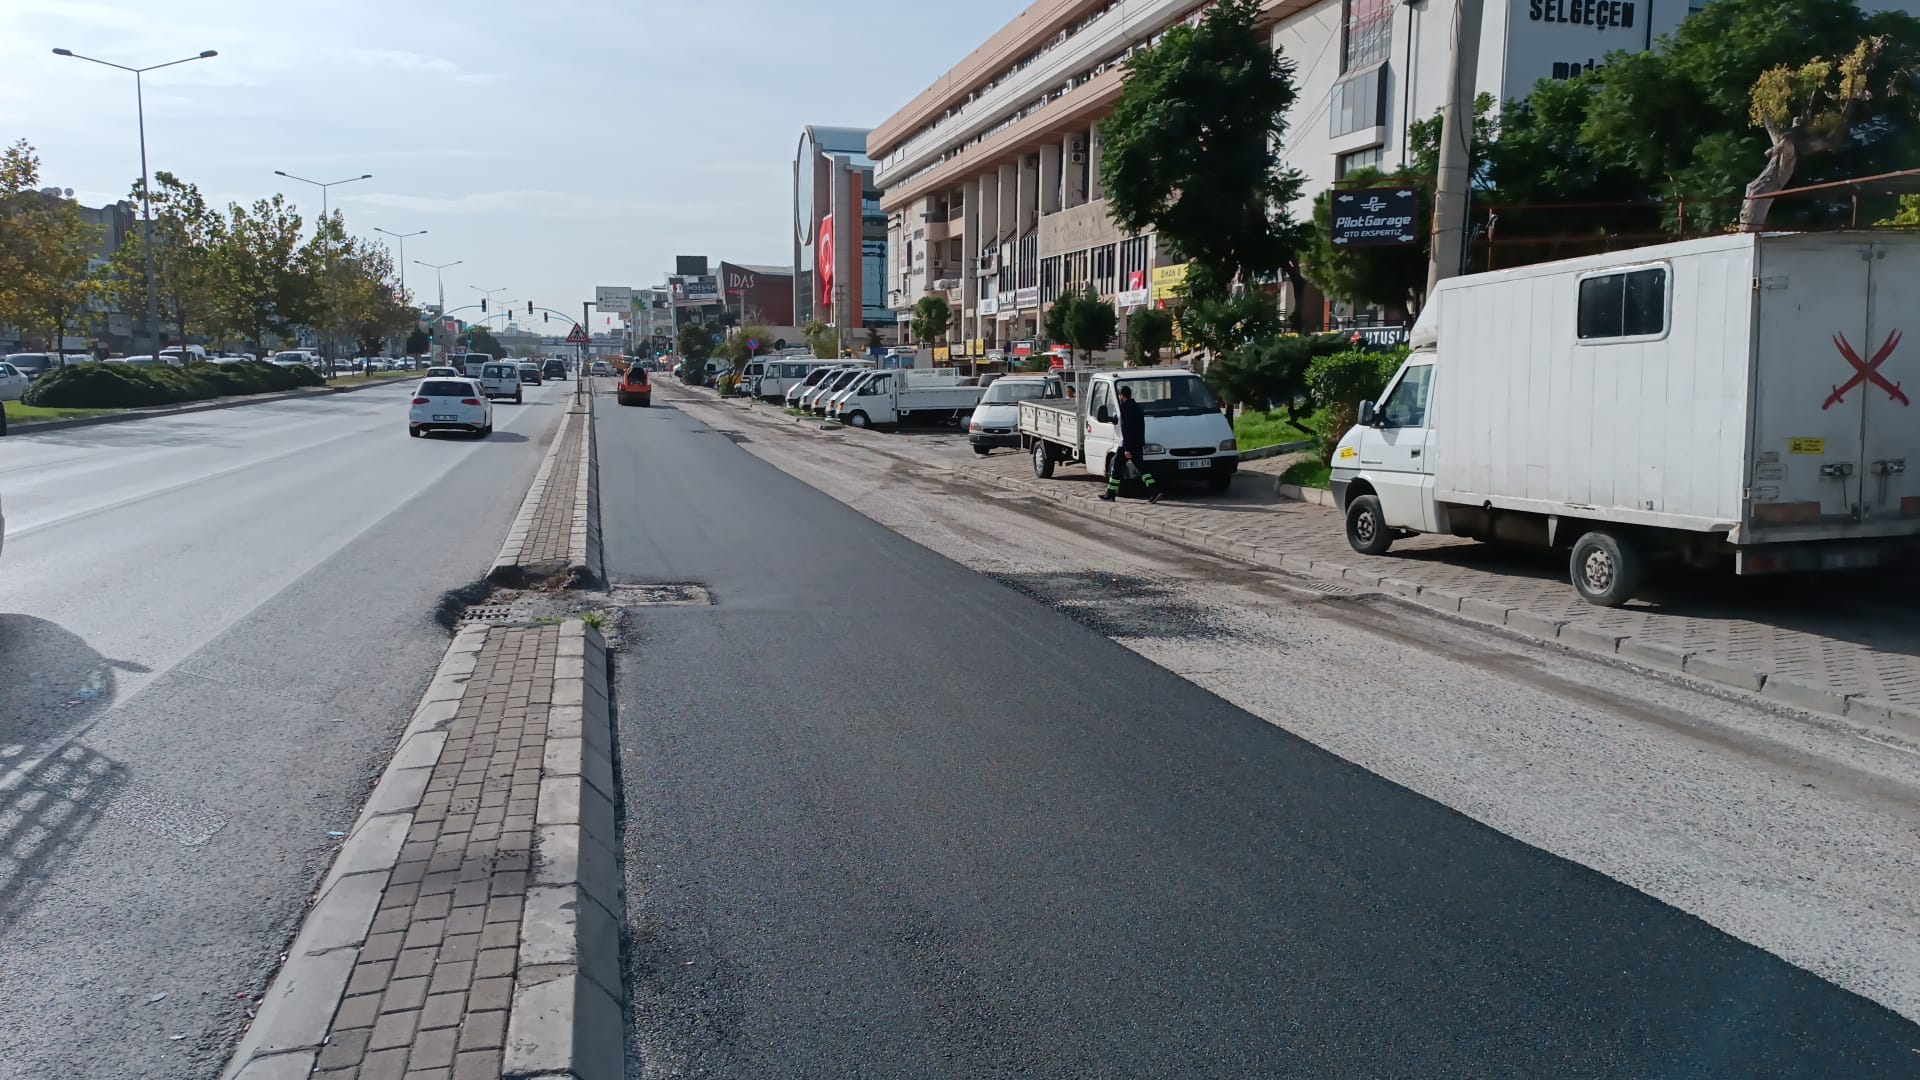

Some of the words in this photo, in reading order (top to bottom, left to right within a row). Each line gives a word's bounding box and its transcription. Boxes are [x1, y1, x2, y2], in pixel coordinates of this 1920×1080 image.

[1529, 0, 1635, 30] SELGEÇEN
[1336, 215, 1411, 228] PilotGarage
[1344, 230, 1361, 238] OTO
